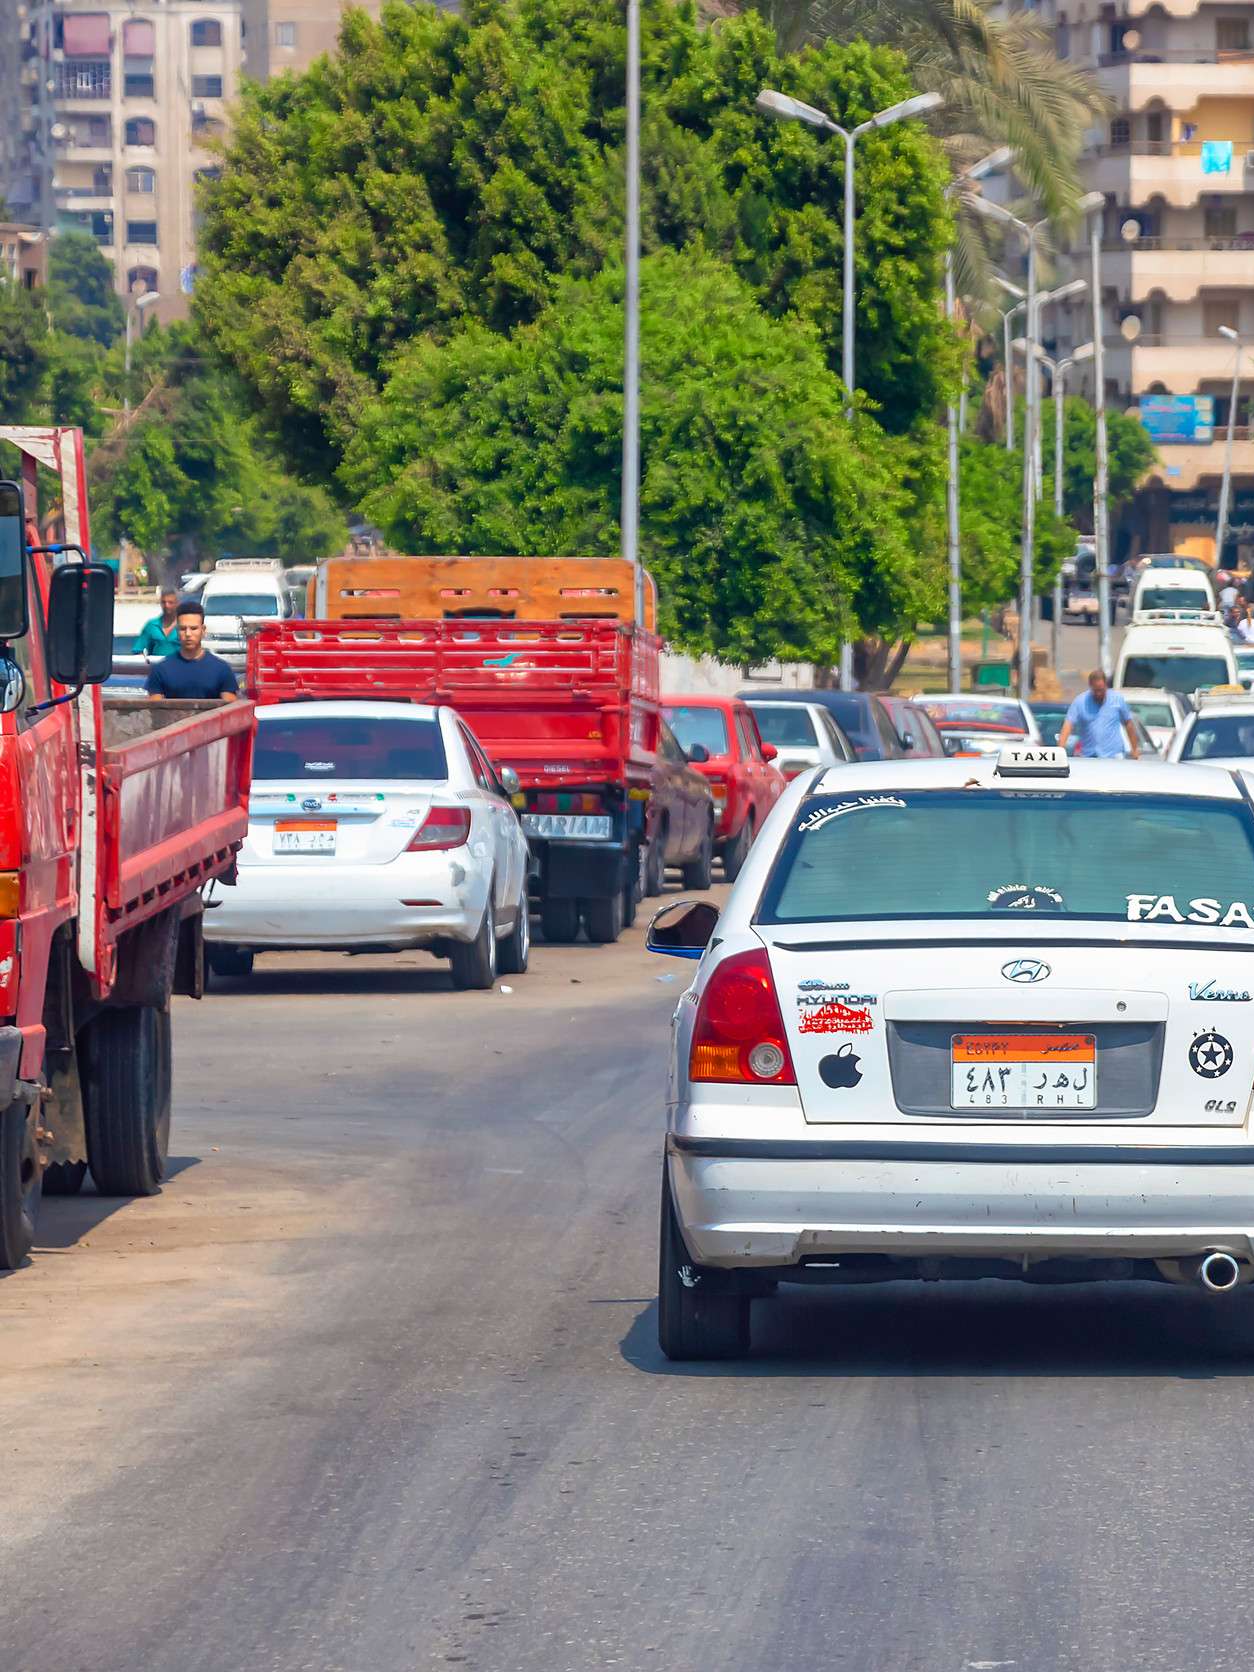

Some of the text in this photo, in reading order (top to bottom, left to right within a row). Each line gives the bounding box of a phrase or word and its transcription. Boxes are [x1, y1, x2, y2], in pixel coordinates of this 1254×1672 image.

[1011, 752, 1057, 761] TAXI
[796, 994, 878, 1006] HYUNDAI
[966, 1066, 1012, 1093] ٤٨٣
[1204, 1099, 1237, 1114] GLS
